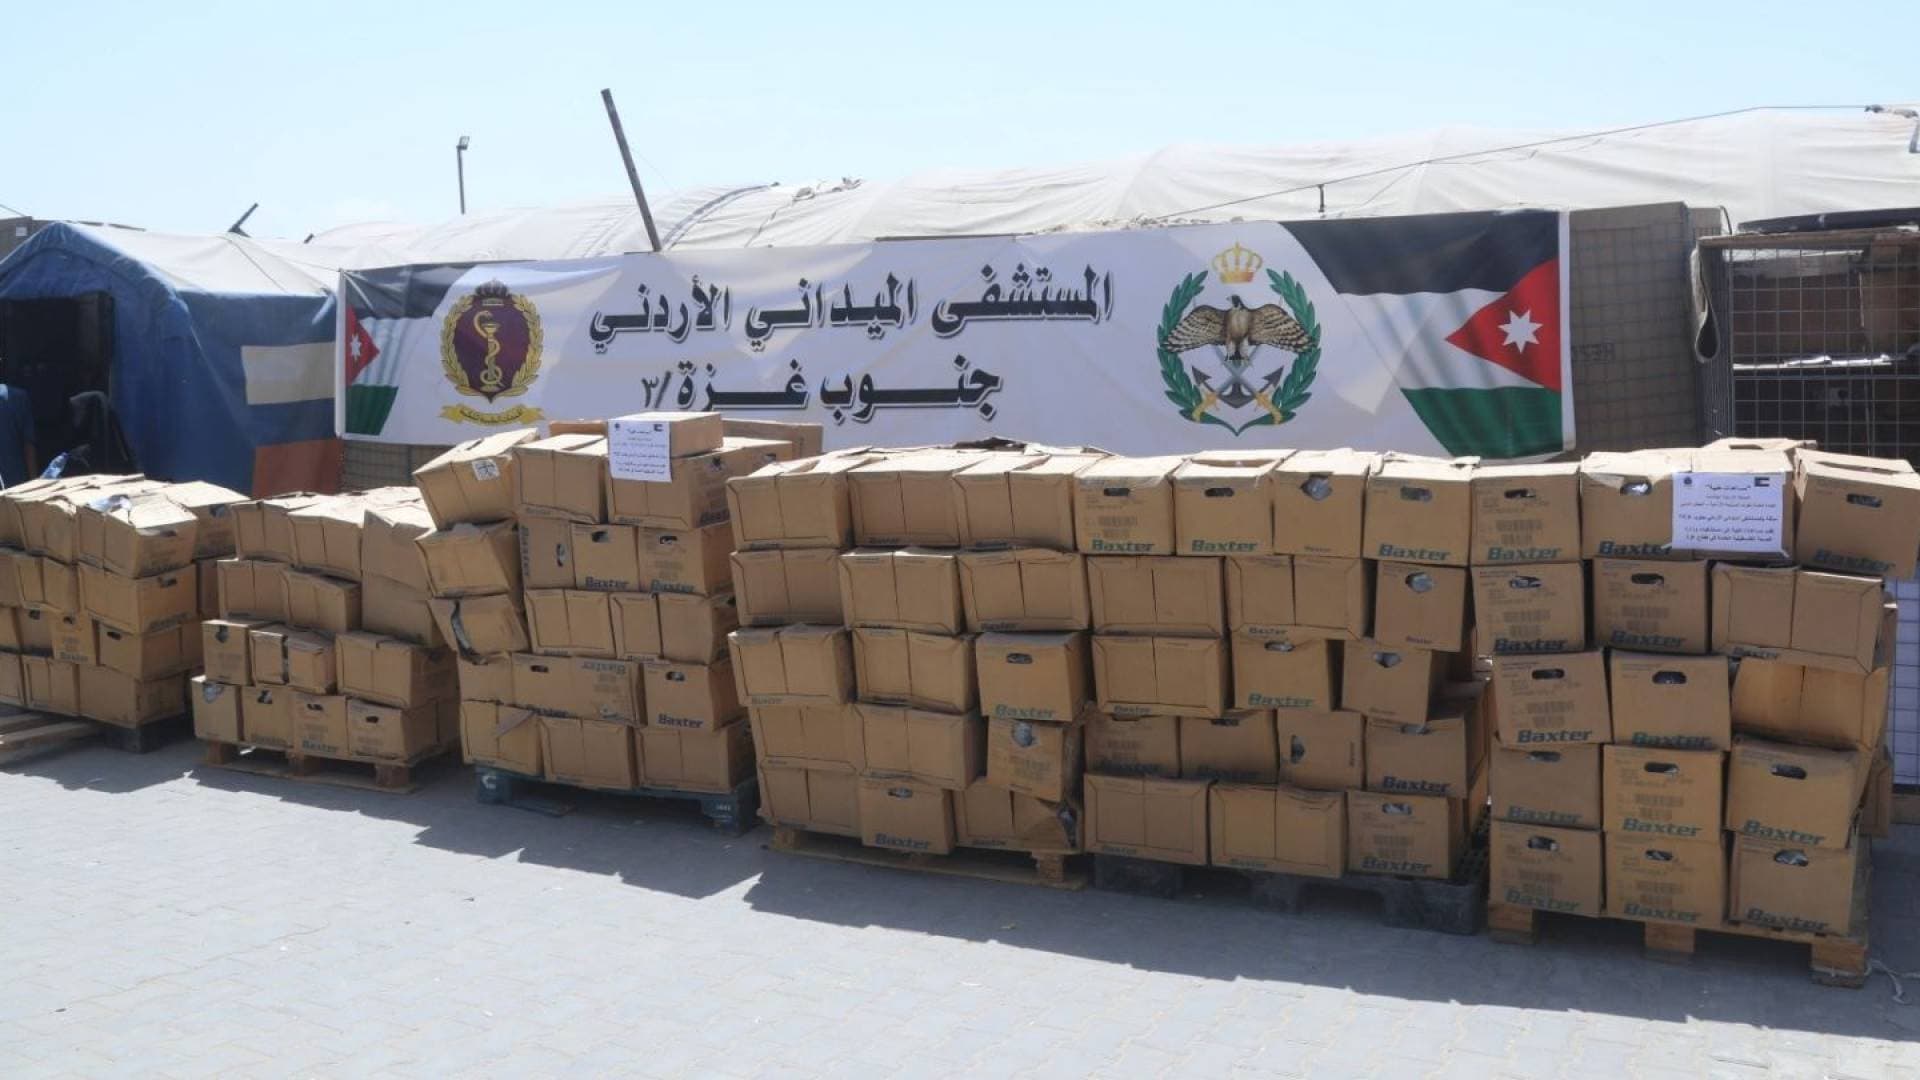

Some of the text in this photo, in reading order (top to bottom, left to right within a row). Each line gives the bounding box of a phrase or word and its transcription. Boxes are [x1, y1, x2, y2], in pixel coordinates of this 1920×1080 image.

[589, 261, 1114, 353] المستشفى الميداني الأردني
[819, 352, 1001, 426] جنوب
[1092, 539, 1155, 553] Baxter
[1192, 539, 1257, 552] Baxter
[1378, 543, 1450, 561] Baxter
[1487, 546, 1563, 561] Baxter
[1598, 540, 1673, 557] Baxter
[1493, 637, 1568, 654] Baxter
[1611, 629, 1687, 647] Baxter
[1249, 692, 1314, 708] Baxter
[996, 704, 1054, 719] Baxter
[658, 713, 703, 729] Baxter
[1518, 729, 1593, 743] Baxter
[1382, 776, 1450, 795] Baxter
[1507, 805, 1583, 824] Baxter
[1623, 817, 1703, 836] Baxter
[1744, 819, 1825, 846] Baxter
[875, 832, 931, 850] Baxter
[1360, 855, 1432, 874] Baxter
[1505, 887, 1581, 912] Baxter
[1624, 901, 1699, 922] Baxter
[1746, 907, 1830, 931] Baxter
